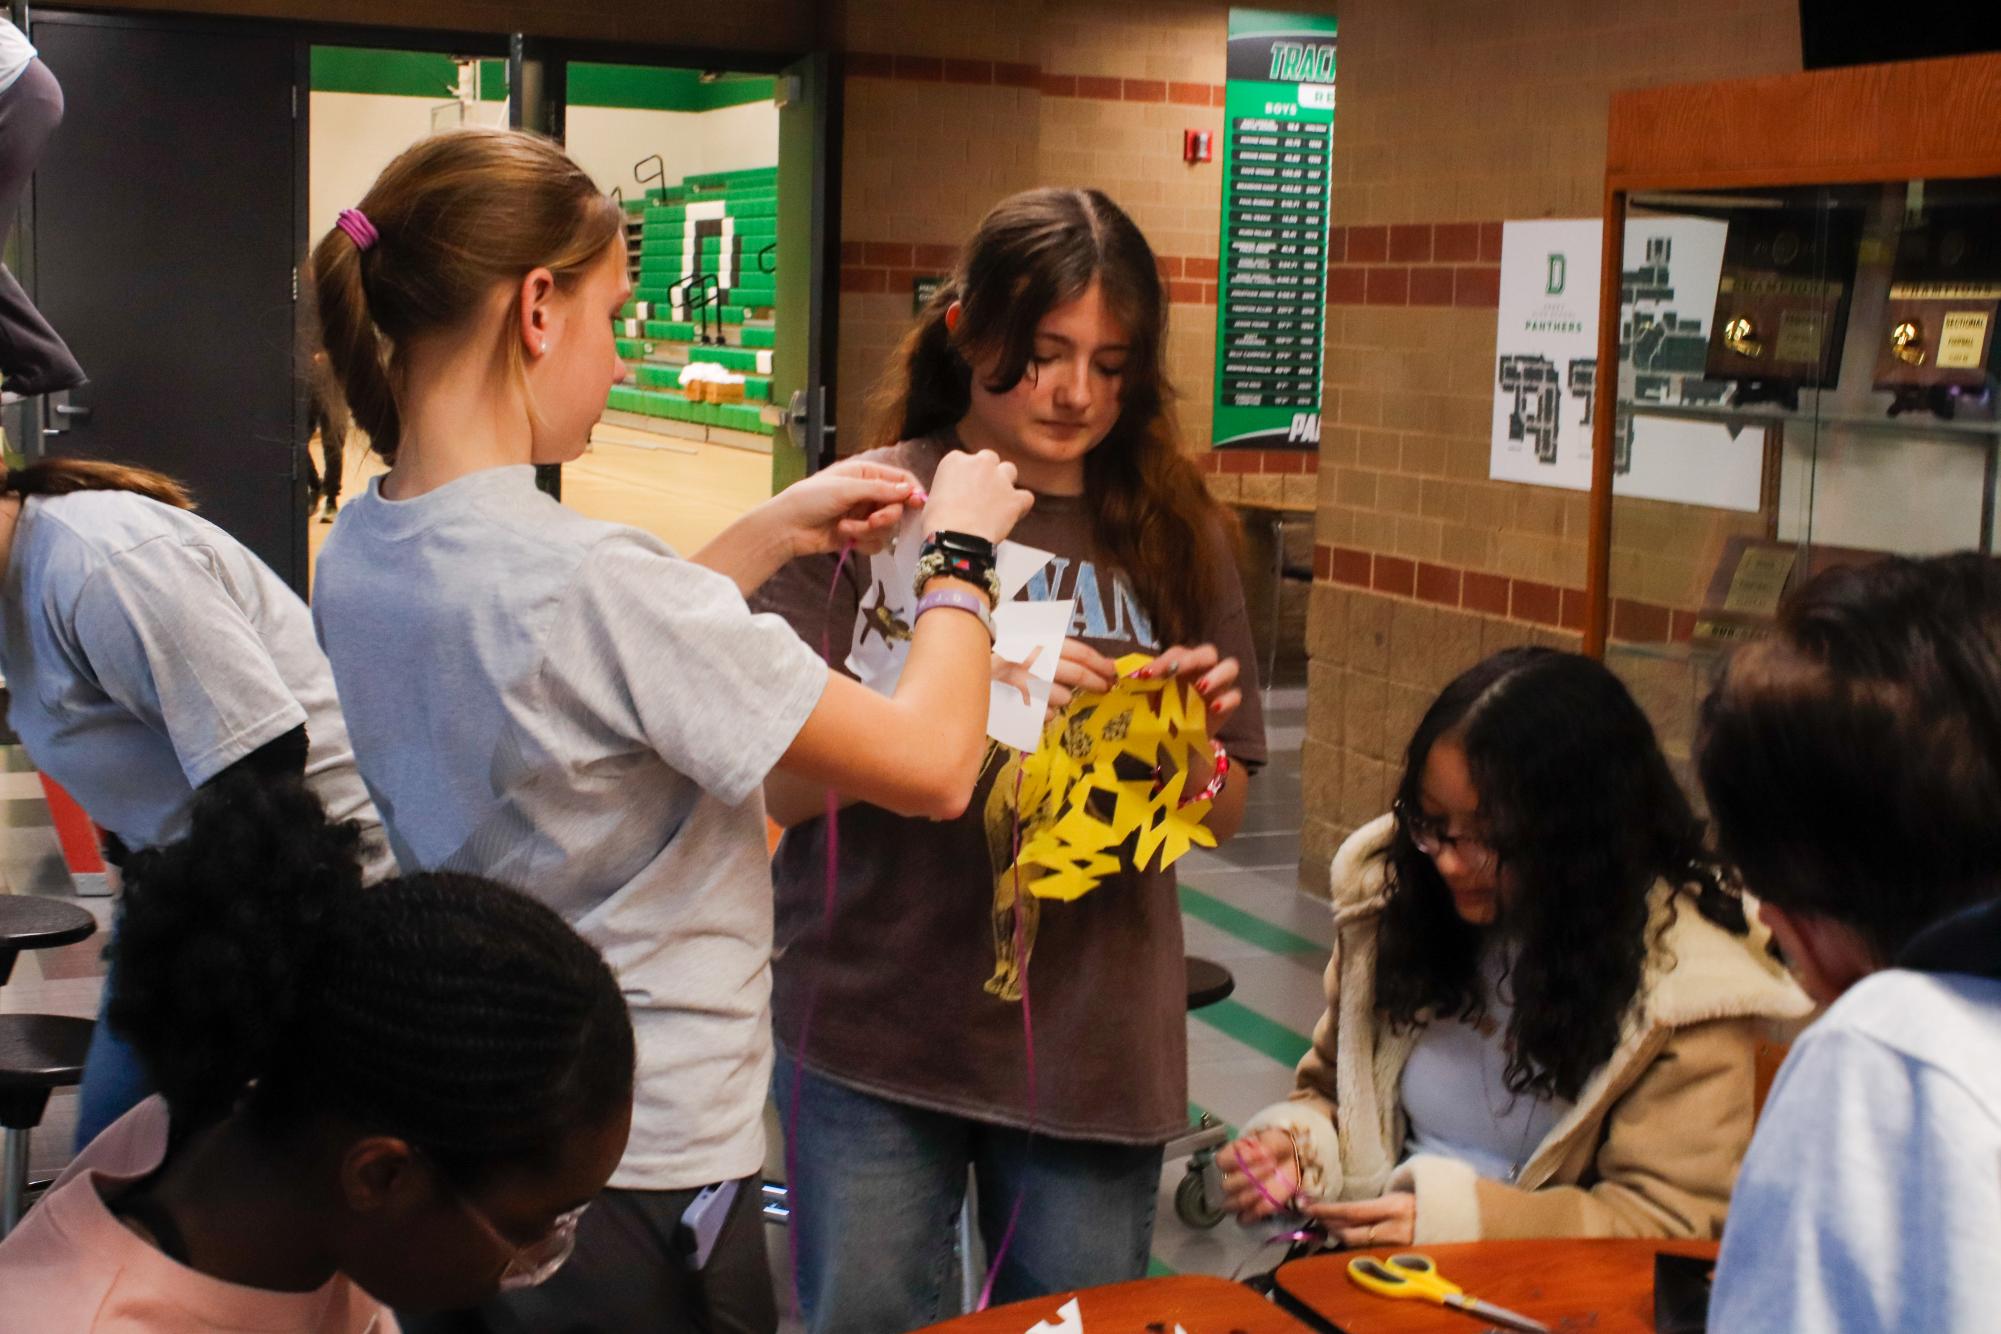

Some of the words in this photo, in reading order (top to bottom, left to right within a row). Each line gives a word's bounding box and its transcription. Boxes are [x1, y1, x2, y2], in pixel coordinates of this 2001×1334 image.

[1264, 102, 1298, 116] BOYS
[1546, 253, 1566, 294] D
[1524, 320, 1583, 333] PANTHERS
